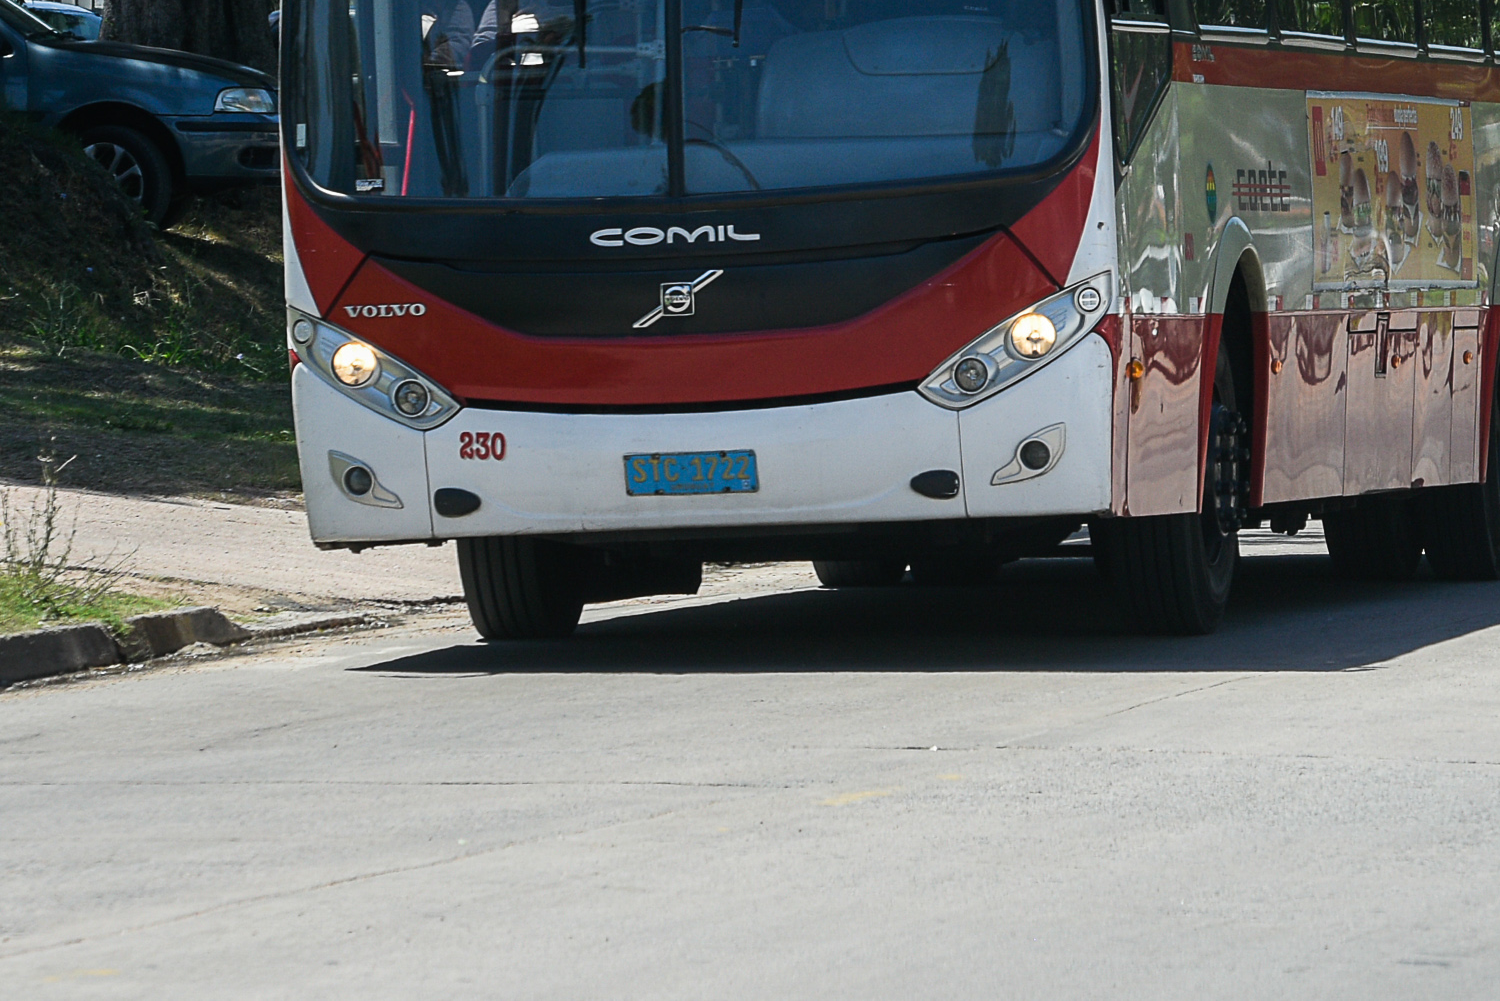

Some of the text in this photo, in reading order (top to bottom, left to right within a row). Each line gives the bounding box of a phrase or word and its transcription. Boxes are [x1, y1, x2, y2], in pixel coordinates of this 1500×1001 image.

[589, 225, 761, 247] COMIL
[344, 303, 427, 319] VOLVO
[459, 431, 507, 460] 230
[633, 456, 751, 483] STC 1722
